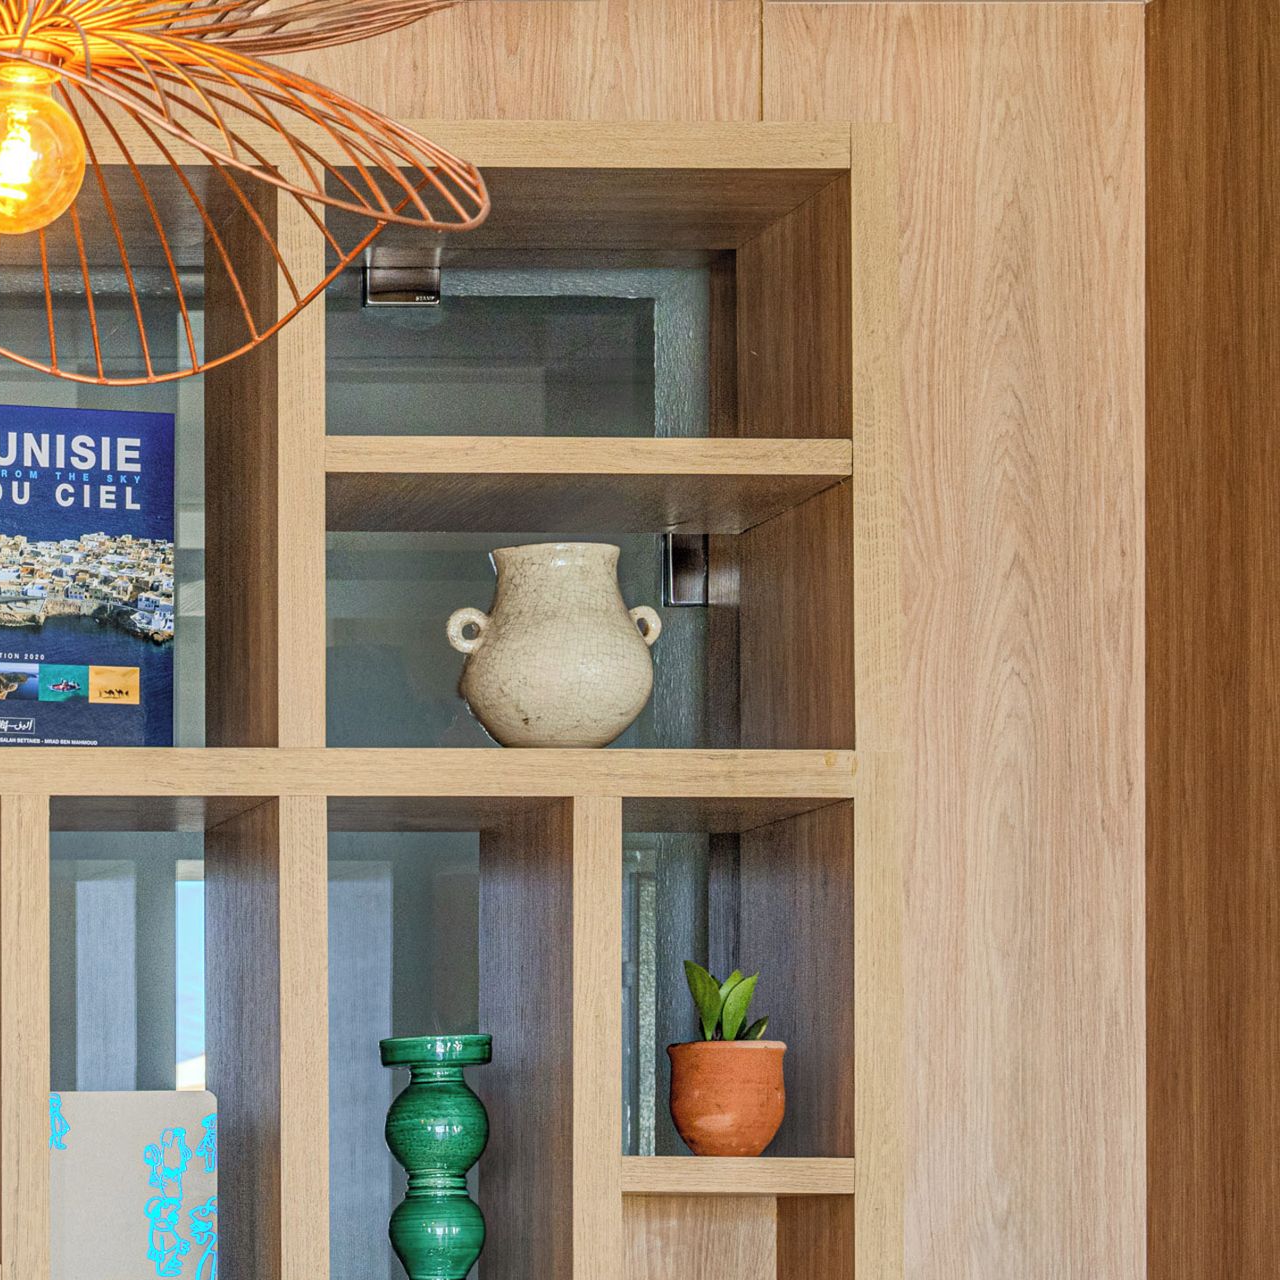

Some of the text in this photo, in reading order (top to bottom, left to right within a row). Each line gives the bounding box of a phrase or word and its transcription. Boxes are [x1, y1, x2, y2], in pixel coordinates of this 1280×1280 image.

[55, 472, 89, 482] THE
[106, 474, 141, 484] SKY
[55, 483, 141, 510] CIEL
[23, 653, 45, 661] 2020
